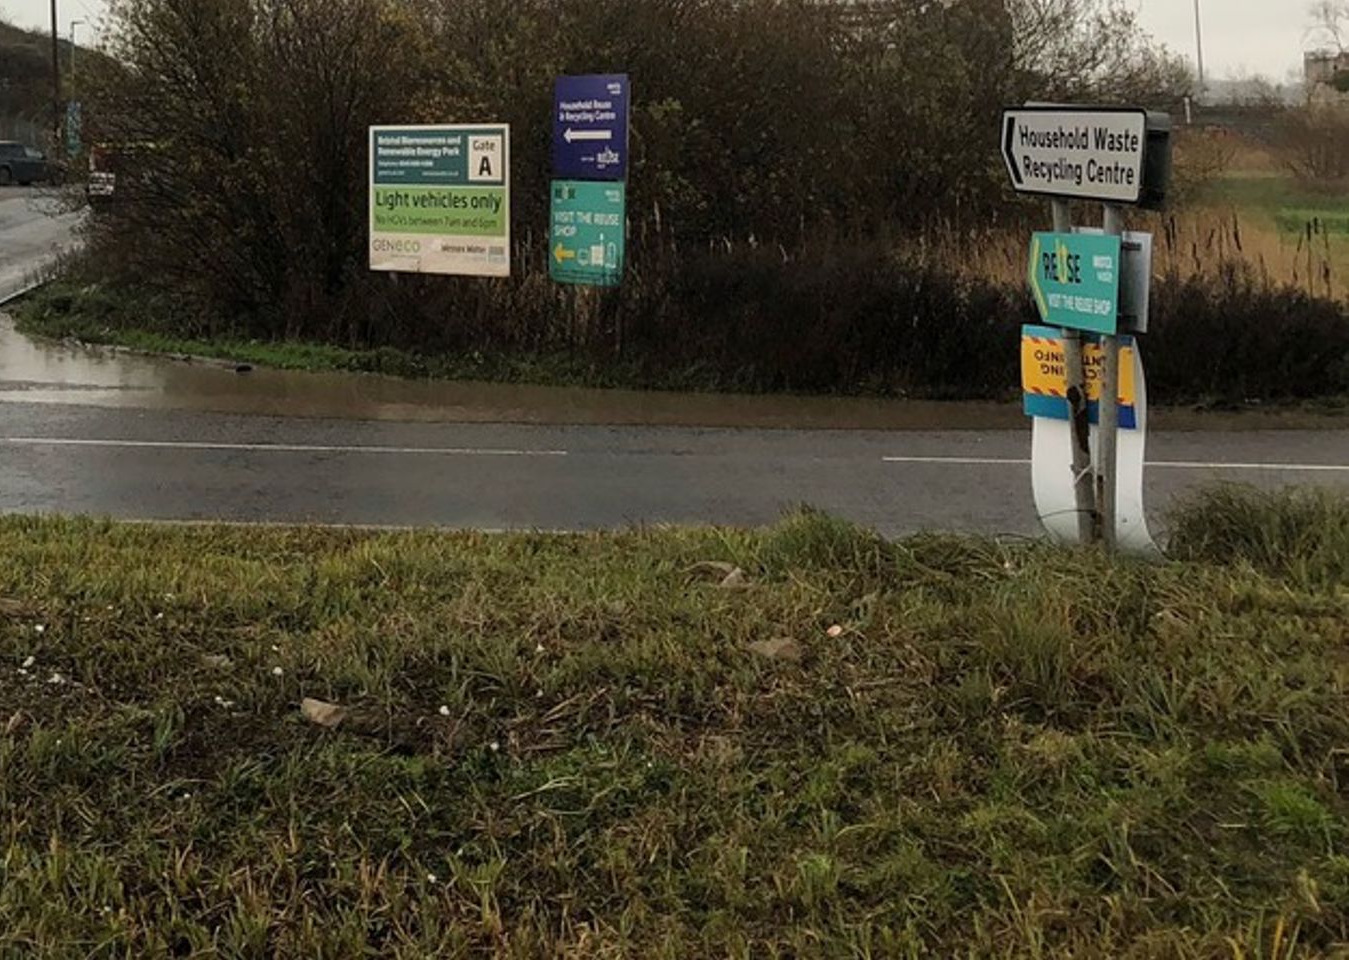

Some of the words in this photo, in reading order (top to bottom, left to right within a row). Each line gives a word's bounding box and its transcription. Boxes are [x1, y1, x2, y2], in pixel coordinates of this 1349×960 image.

[473, 140, 496, 152] Gate
[1019, 125, 1089, 149] Household
[1094, 127, 1139, 152] Waste
[479, 156, 492, 177] A
[1023, 155, 1082, 185] Recycling
[1087, 158, 1134, 184] Centre
[376, 192, 410, 211] Light
[412, 192, 468, 209] vehicles
[471, 193, 501, 214] only
